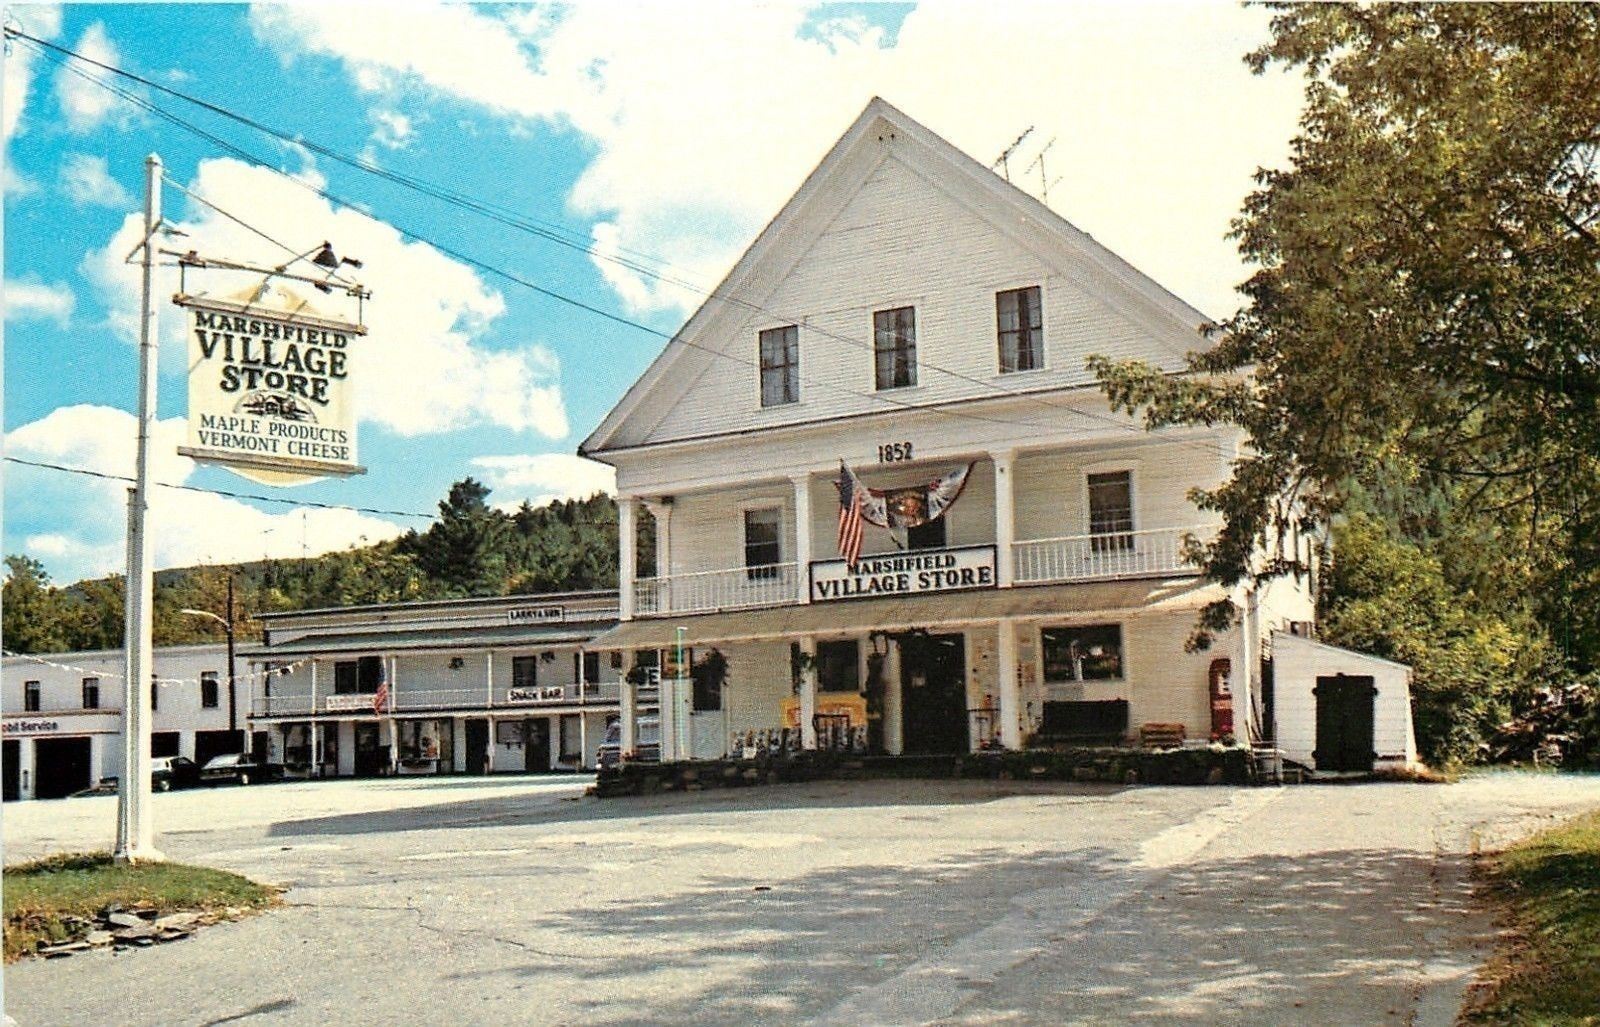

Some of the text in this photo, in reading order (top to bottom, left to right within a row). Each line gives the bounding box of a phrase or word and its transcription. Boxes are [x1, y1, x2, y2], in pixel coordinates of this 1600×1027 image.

[195, 311, 347, 348] MARSHFIELD
[194, 329, 347, 378] VILLAGE
[220, 365, 329, 405] STORE
[200, 414, 347, 443] MAPLE PRODUCTS
[198, 430, 349, 460] VERMONT CHEESE
[878, 442, 913, 463] 1852
[847, 555, 956, 576] MARSHFIELD
[816, 566, 992, 597] VILLAGE STORE
[510, 689, 561, 701] SNACK BAR
[2, 721, 58, 732] obil Service
